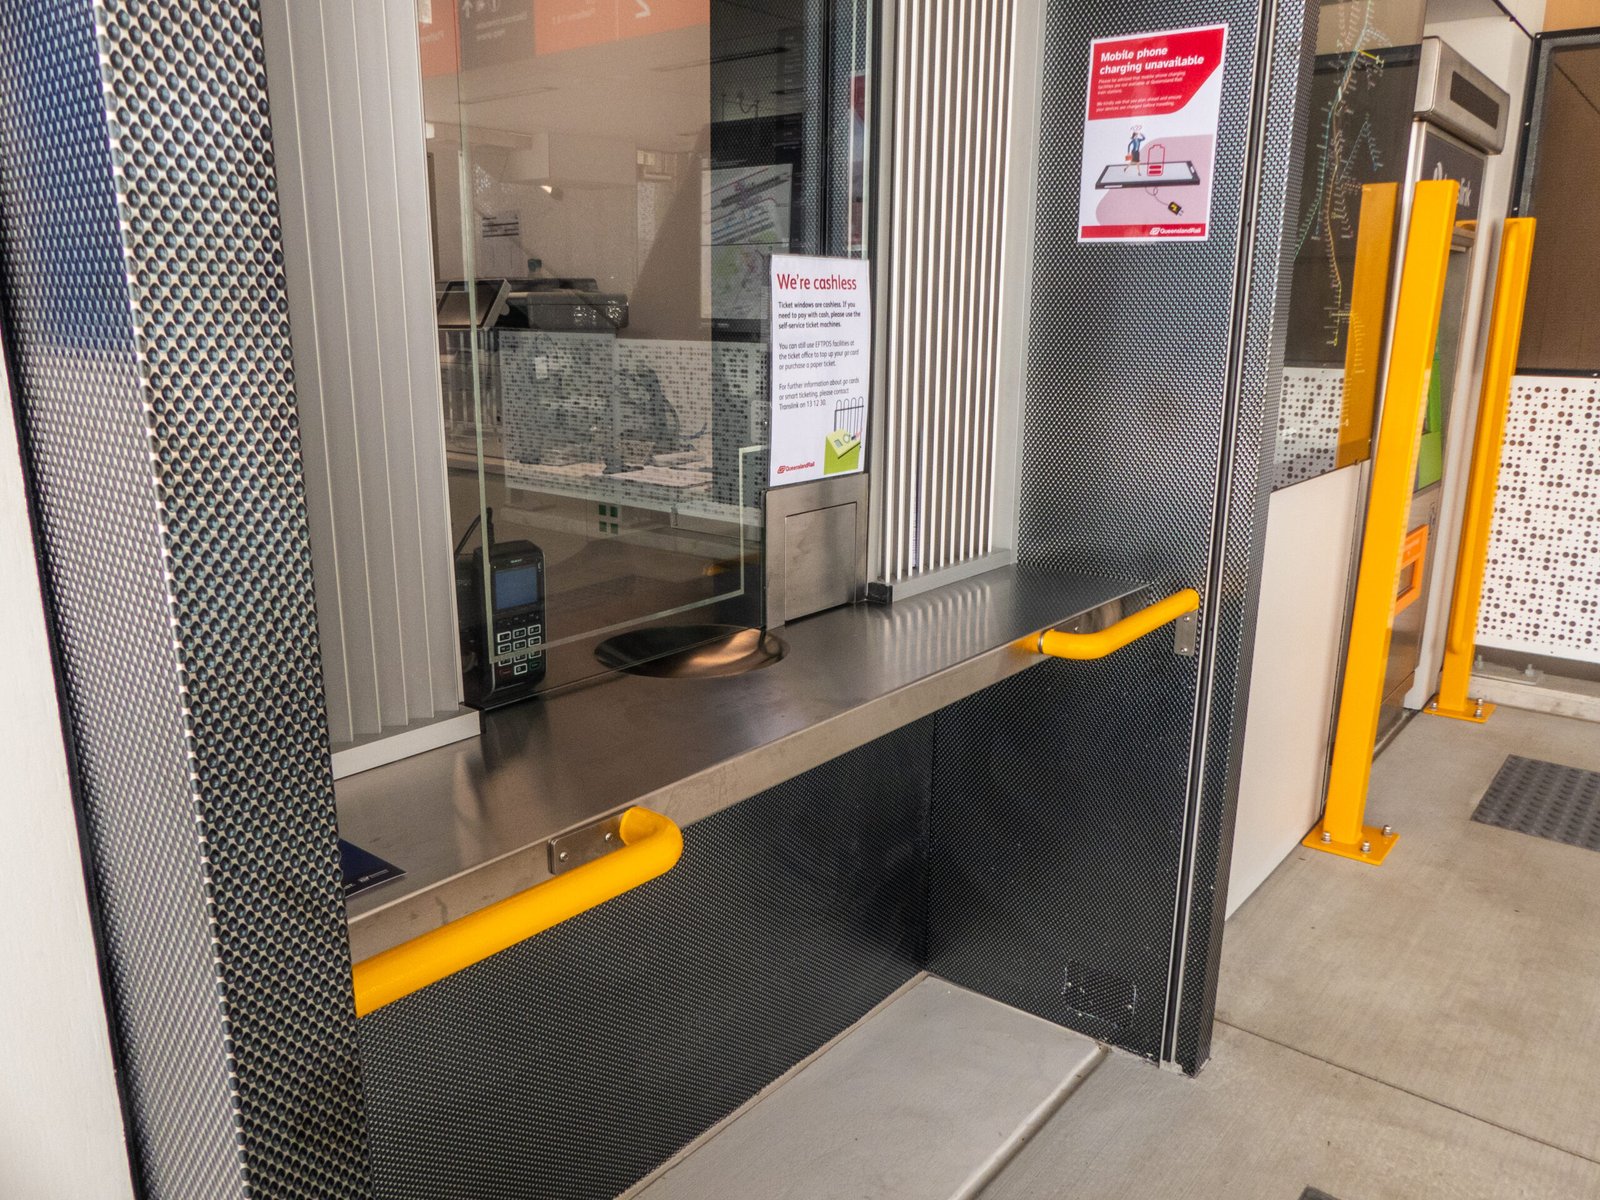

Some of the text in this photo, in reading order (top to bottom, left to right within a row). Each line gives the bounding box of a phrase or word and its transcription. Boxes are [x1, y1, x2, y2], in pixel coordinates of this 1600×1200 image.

[1100, 47, 1168, 62] Mobile phone
[1100, 56, 1204, 75] charging unavailable
[777, 274, 857, 290] We're cashless
[785, 362, 805, 371] purchase
[779, 402, 798, 410] Translink
[785, 461, 815, 472] QueenslandRail
